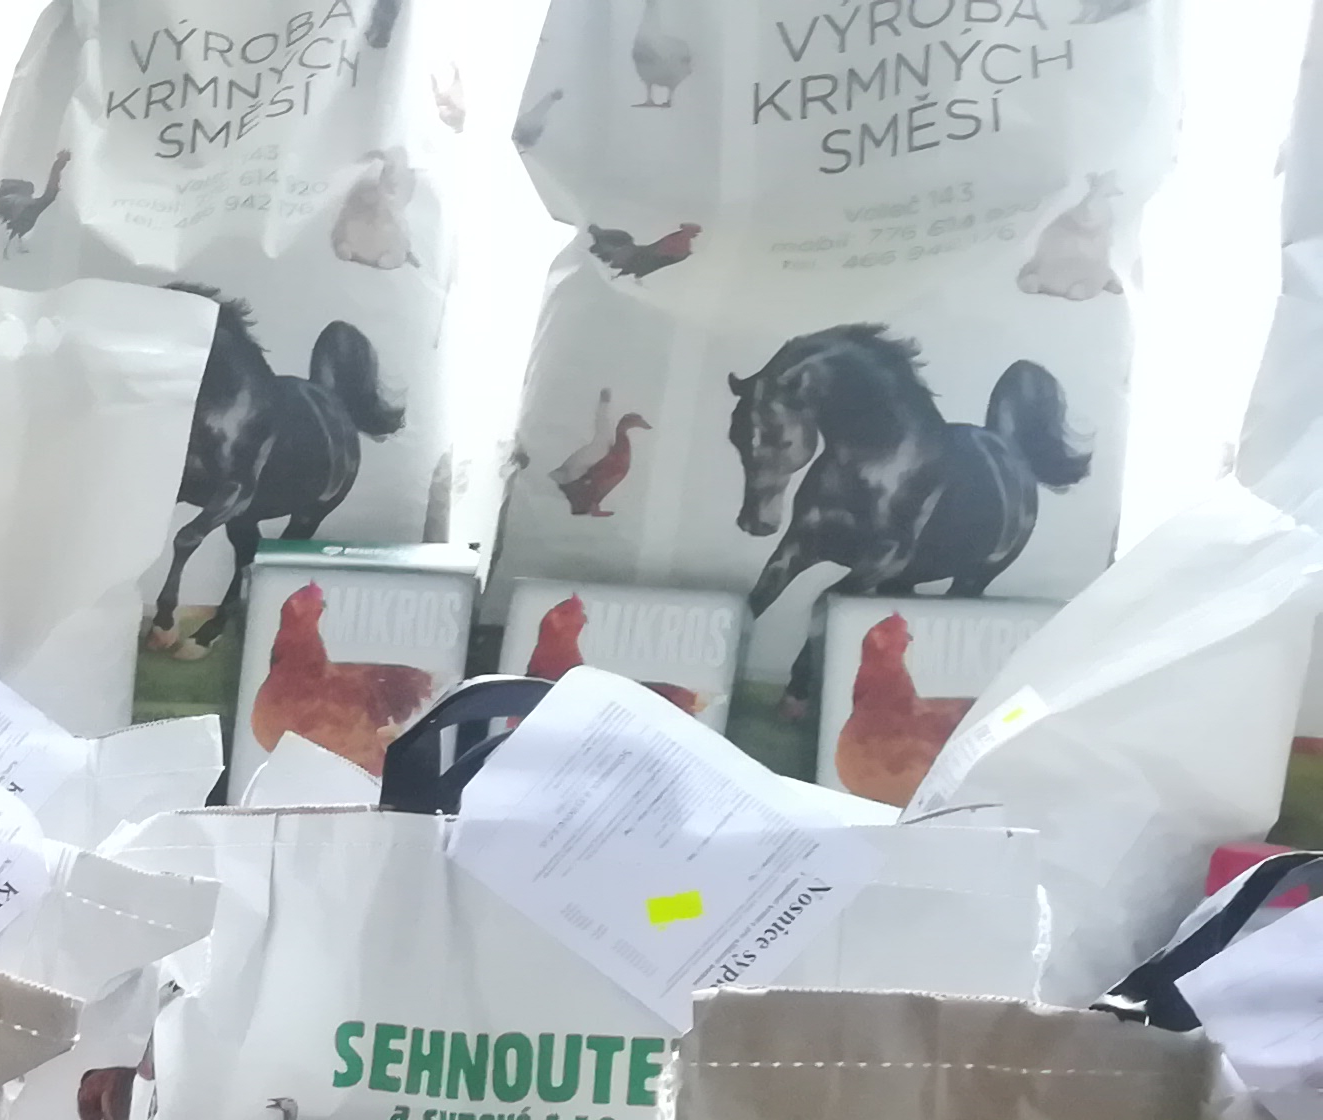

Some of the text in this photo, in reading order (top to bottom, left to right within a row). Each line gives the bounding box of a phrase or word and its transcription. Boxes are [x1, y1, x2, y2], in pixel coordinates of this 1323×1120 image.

[106, 37, 360, 120] KRMNÝCH
[130, 0, 356, 74] VÝROBA
[752, 27, 1073, 125] KRMNÝCH
[818, 89, 1004, 174] SMĚSÍ
[755, 877, 834, 949] Nosnice
[331, 1020, 680, 1107] SEHNOUTE
